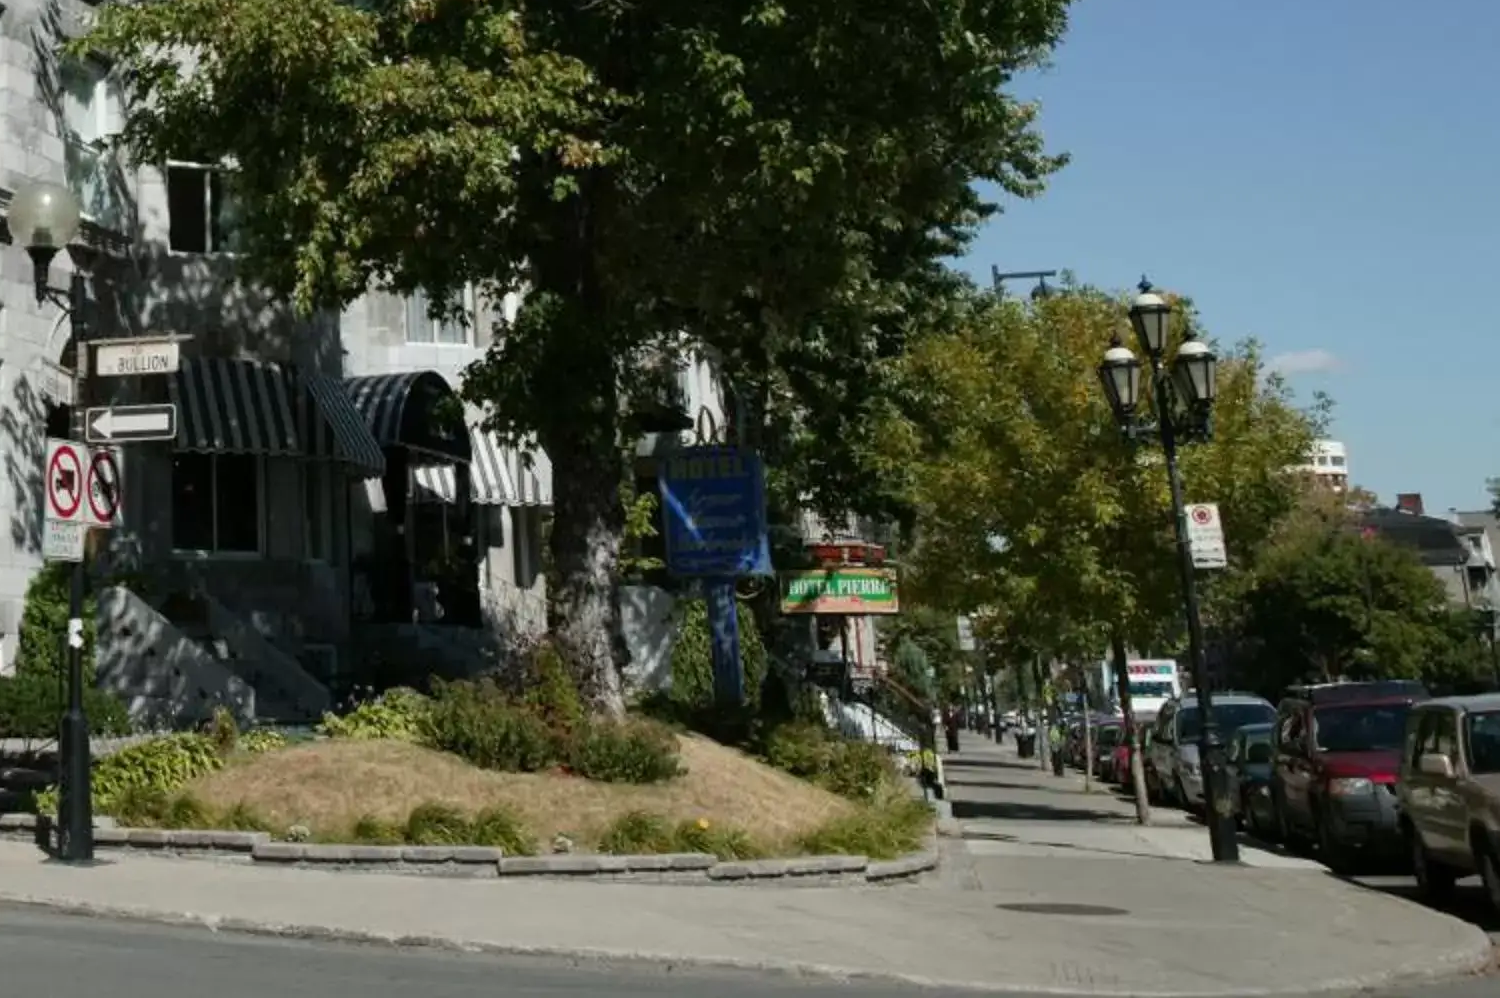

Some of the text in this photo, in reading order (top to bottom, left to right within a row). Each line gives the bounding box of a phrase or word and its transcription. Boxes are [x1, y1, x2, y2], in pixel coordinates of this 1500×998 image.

[118, 354, 169, 373] BULLION
[668, 456, 750, 480] HOTEL
[789, 578, 833, 595] HOTEL
